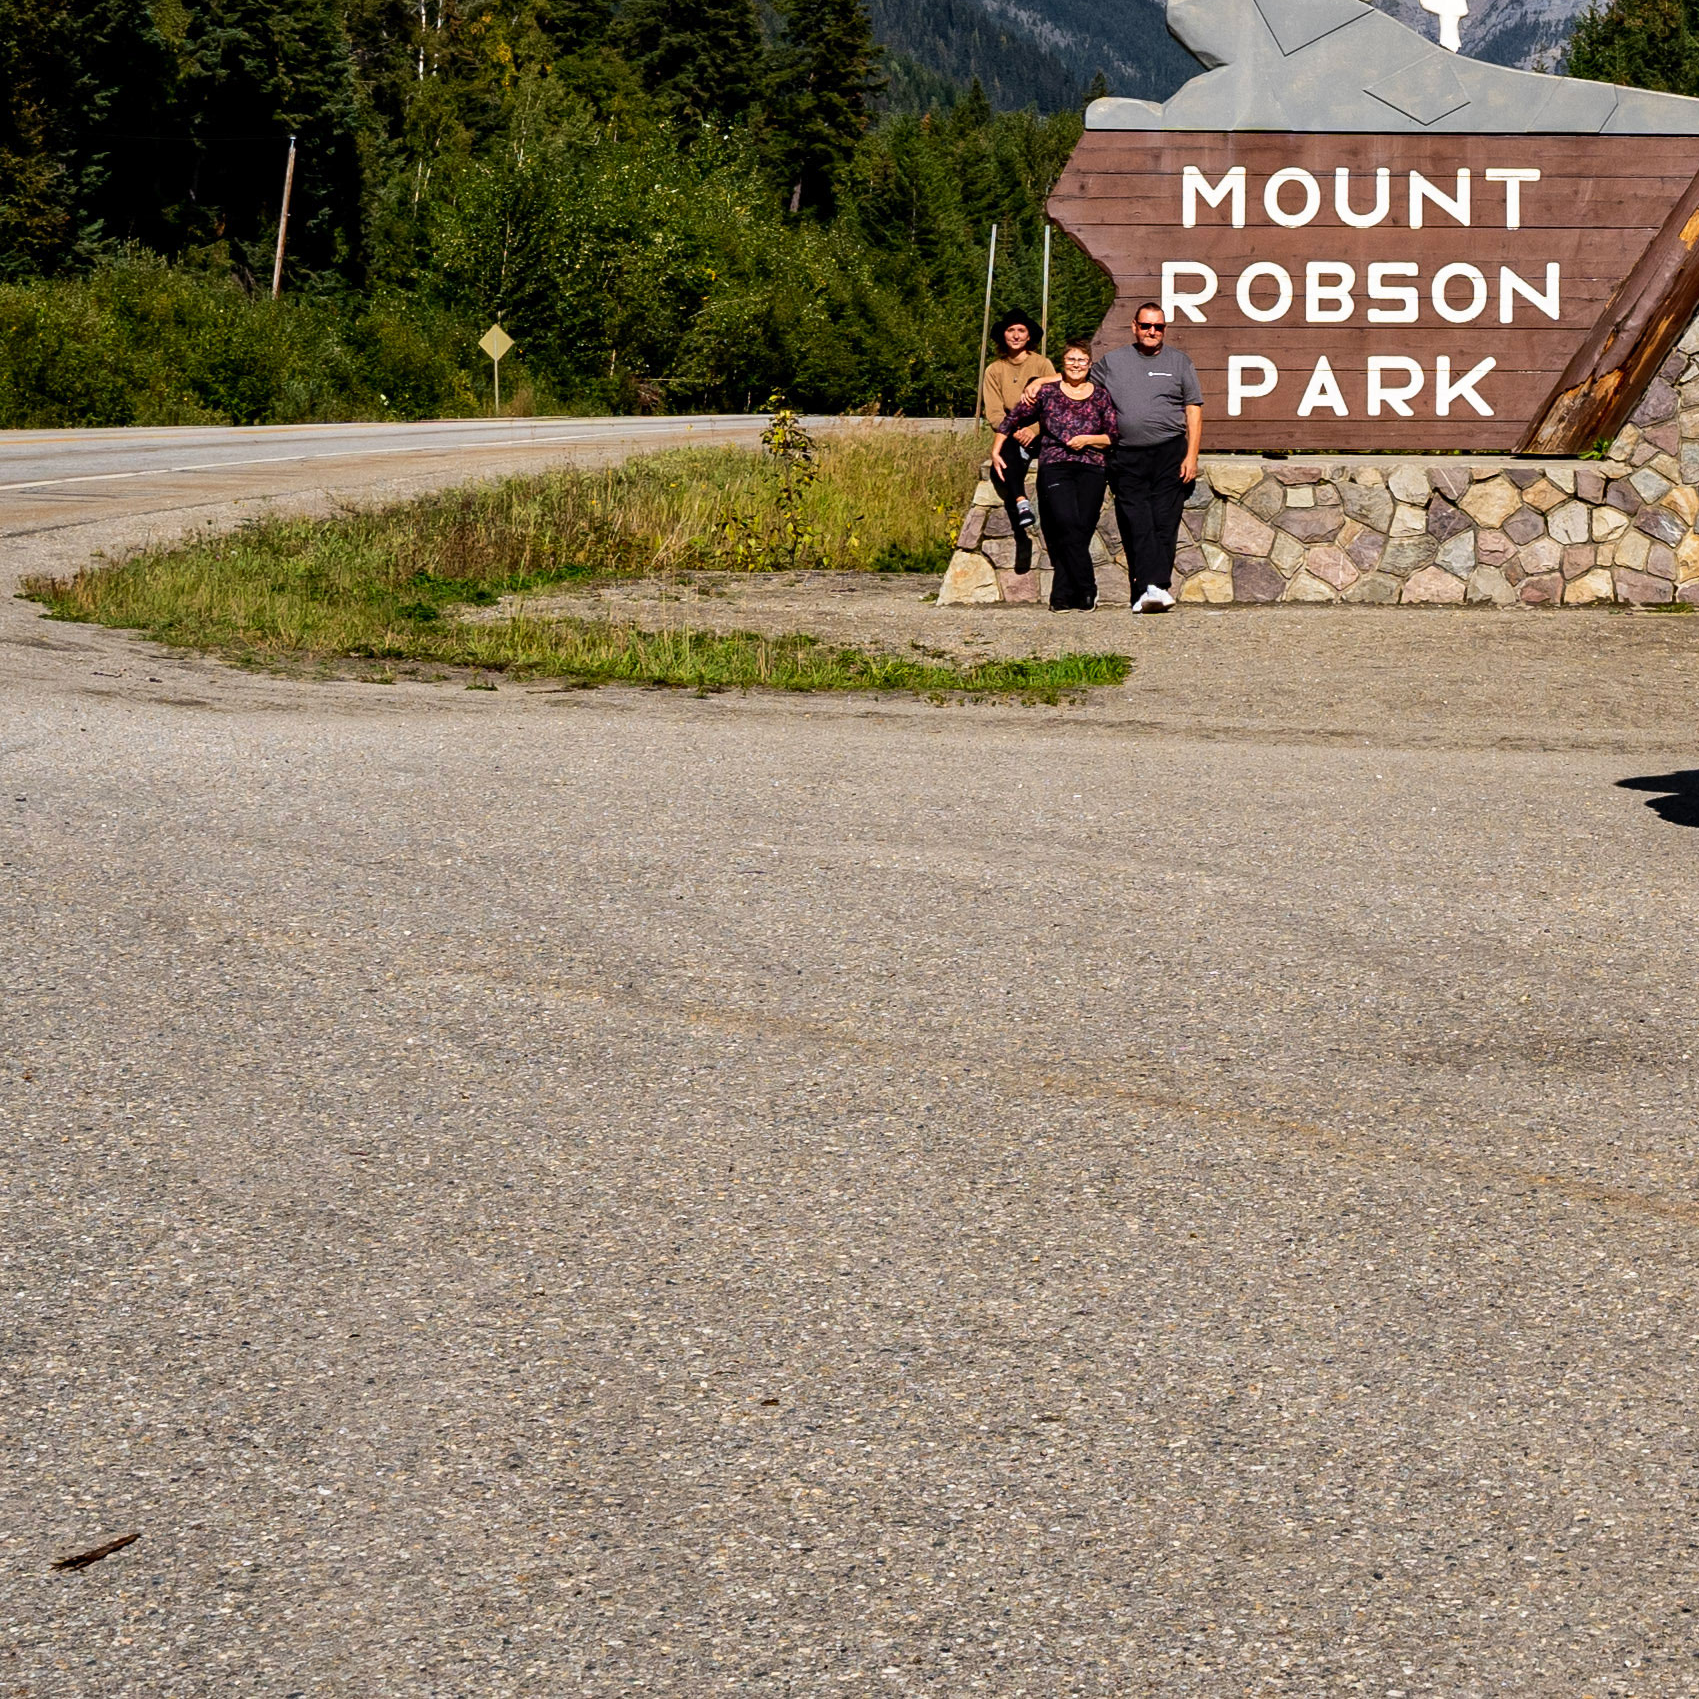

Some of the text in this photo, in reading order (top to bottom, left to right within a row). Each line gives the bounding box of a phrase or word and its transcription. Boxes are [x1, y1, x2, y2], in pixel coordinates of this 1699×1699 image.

[1182, 165, 1541, 229] MOUNT
[1161, 261, 1560, 323] ROBSON
[1227, 355, 1497, 417] PARK
